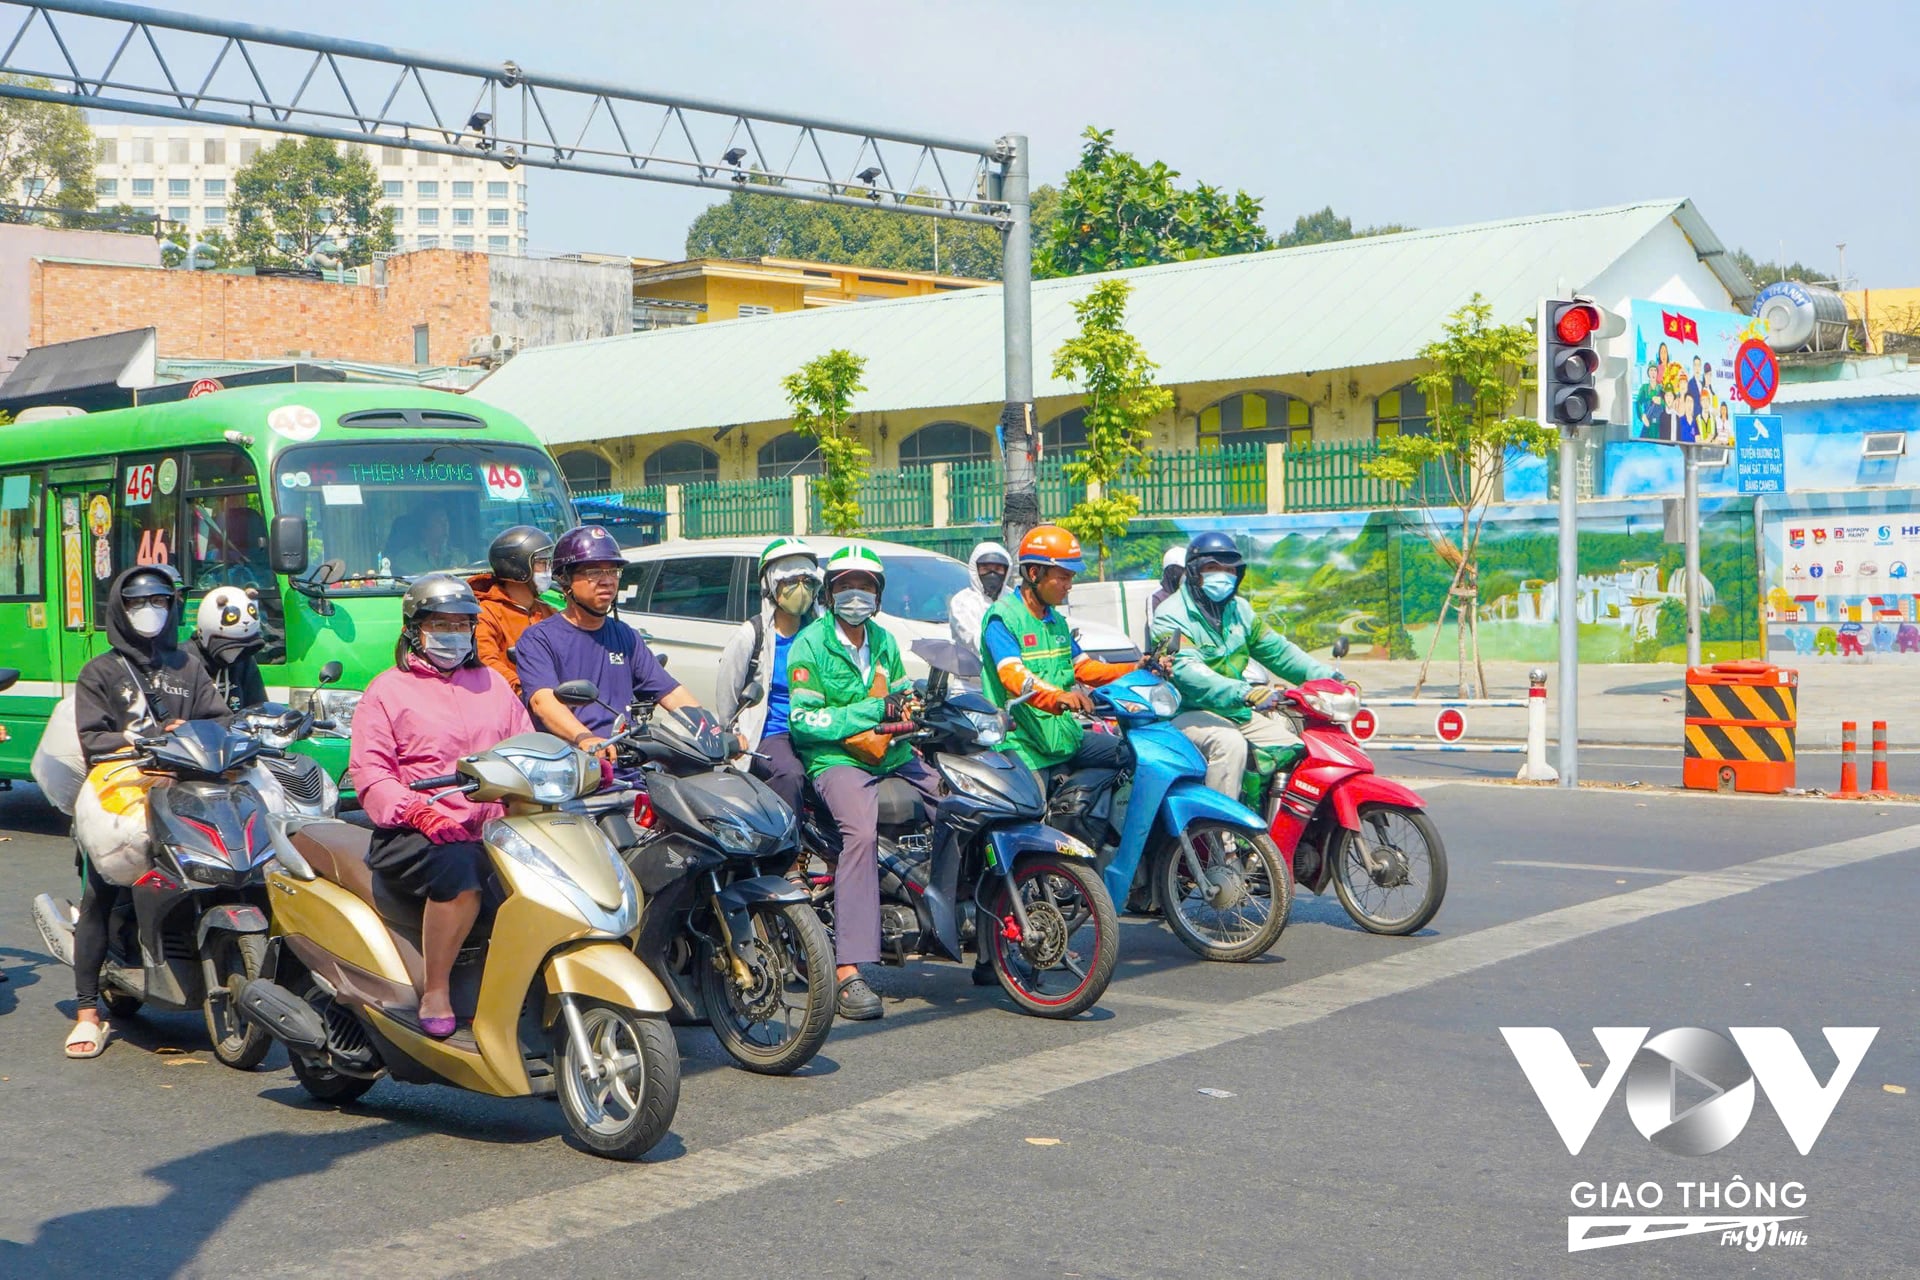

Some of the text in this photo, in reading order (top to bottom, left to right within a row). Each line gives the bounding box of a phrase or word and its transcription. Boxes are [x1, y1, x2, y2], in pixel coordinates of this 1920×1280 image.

[127, 466, 153, 500] 46
[488, 463, 522, 489] 46
[1759, 480, 1778, 491] CAMERA
[136, 528, 168, 566] 46
